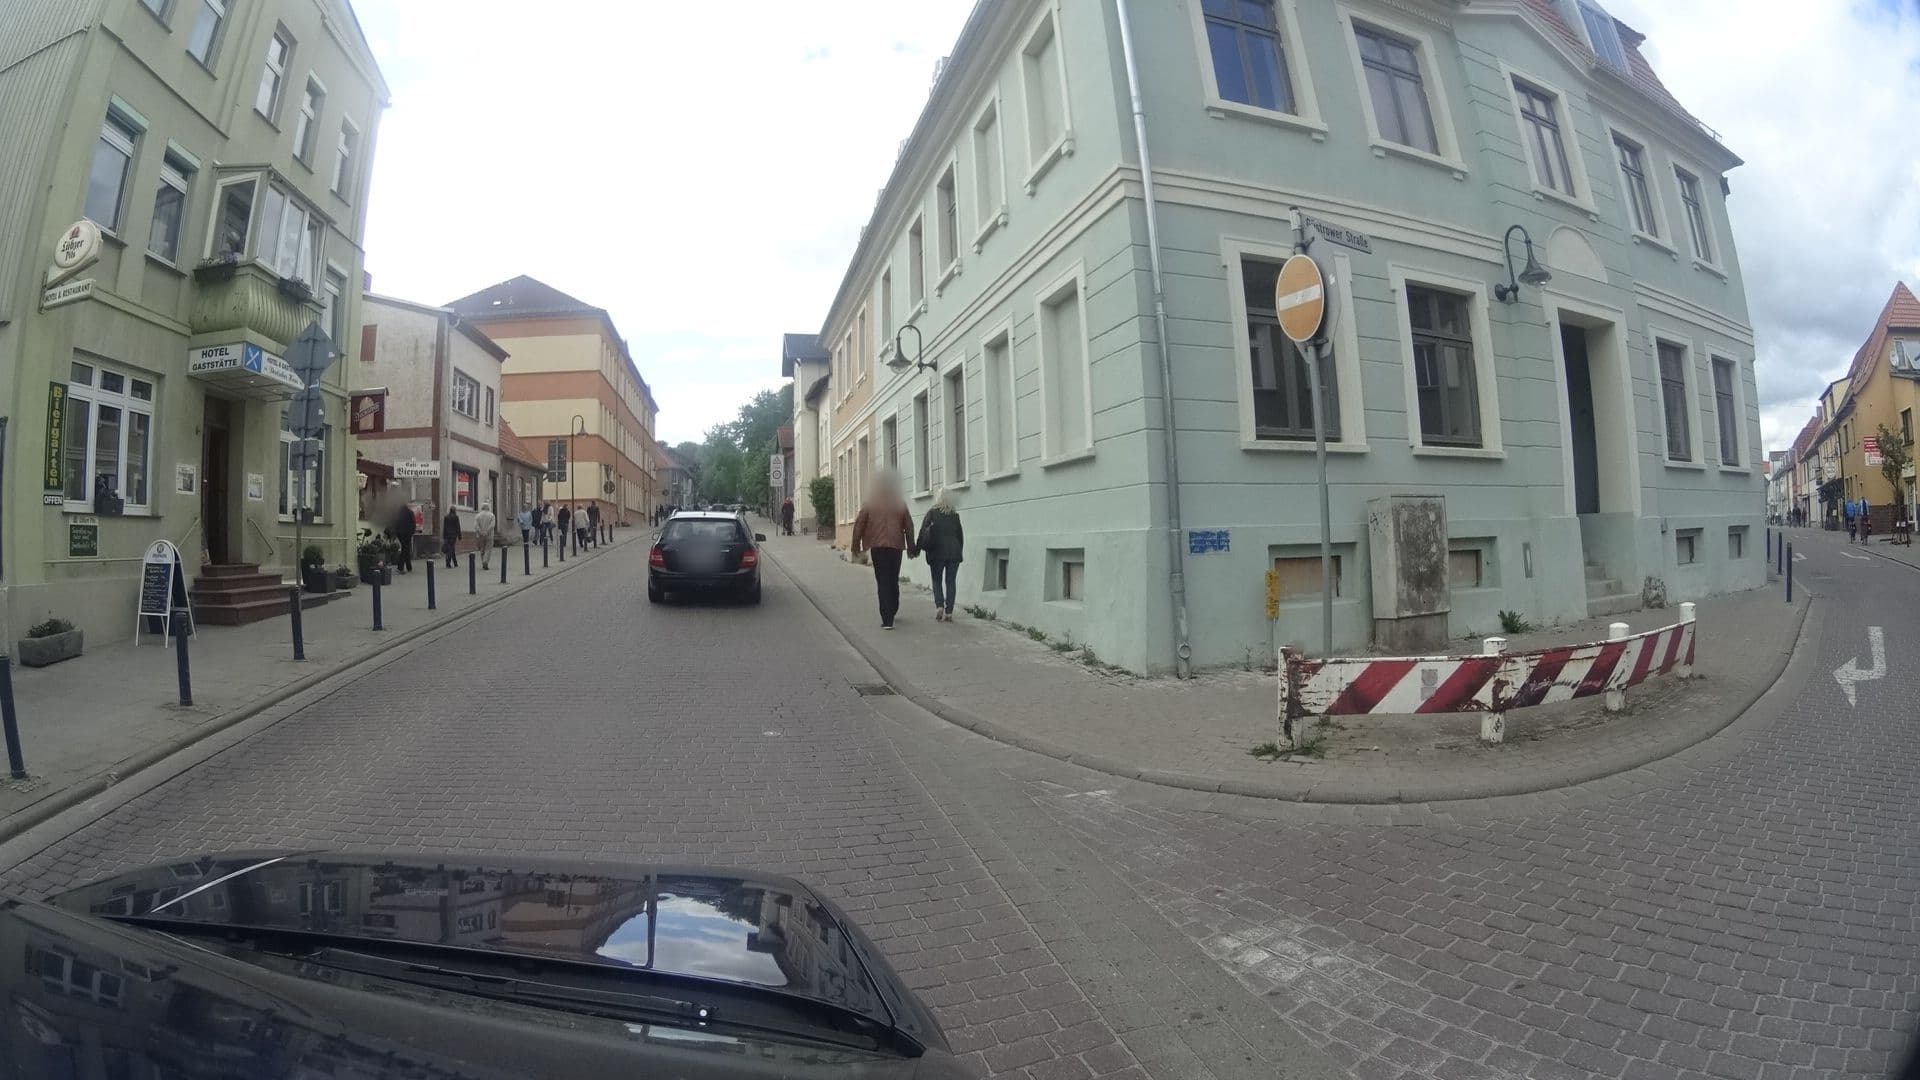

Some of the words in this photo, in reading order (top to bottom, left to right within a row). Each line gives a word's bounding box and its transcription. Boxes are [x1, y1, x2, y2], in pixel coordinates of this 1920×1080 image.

[201, 347, 230, 359] HOTEL
[192, 358, 238, 371] GASTSTÄTTE
[50, 386, 62, 487] Biergarten
[397, 467, 438, 477] Biergarten
[44, 496, 62, 505] OFFEN
